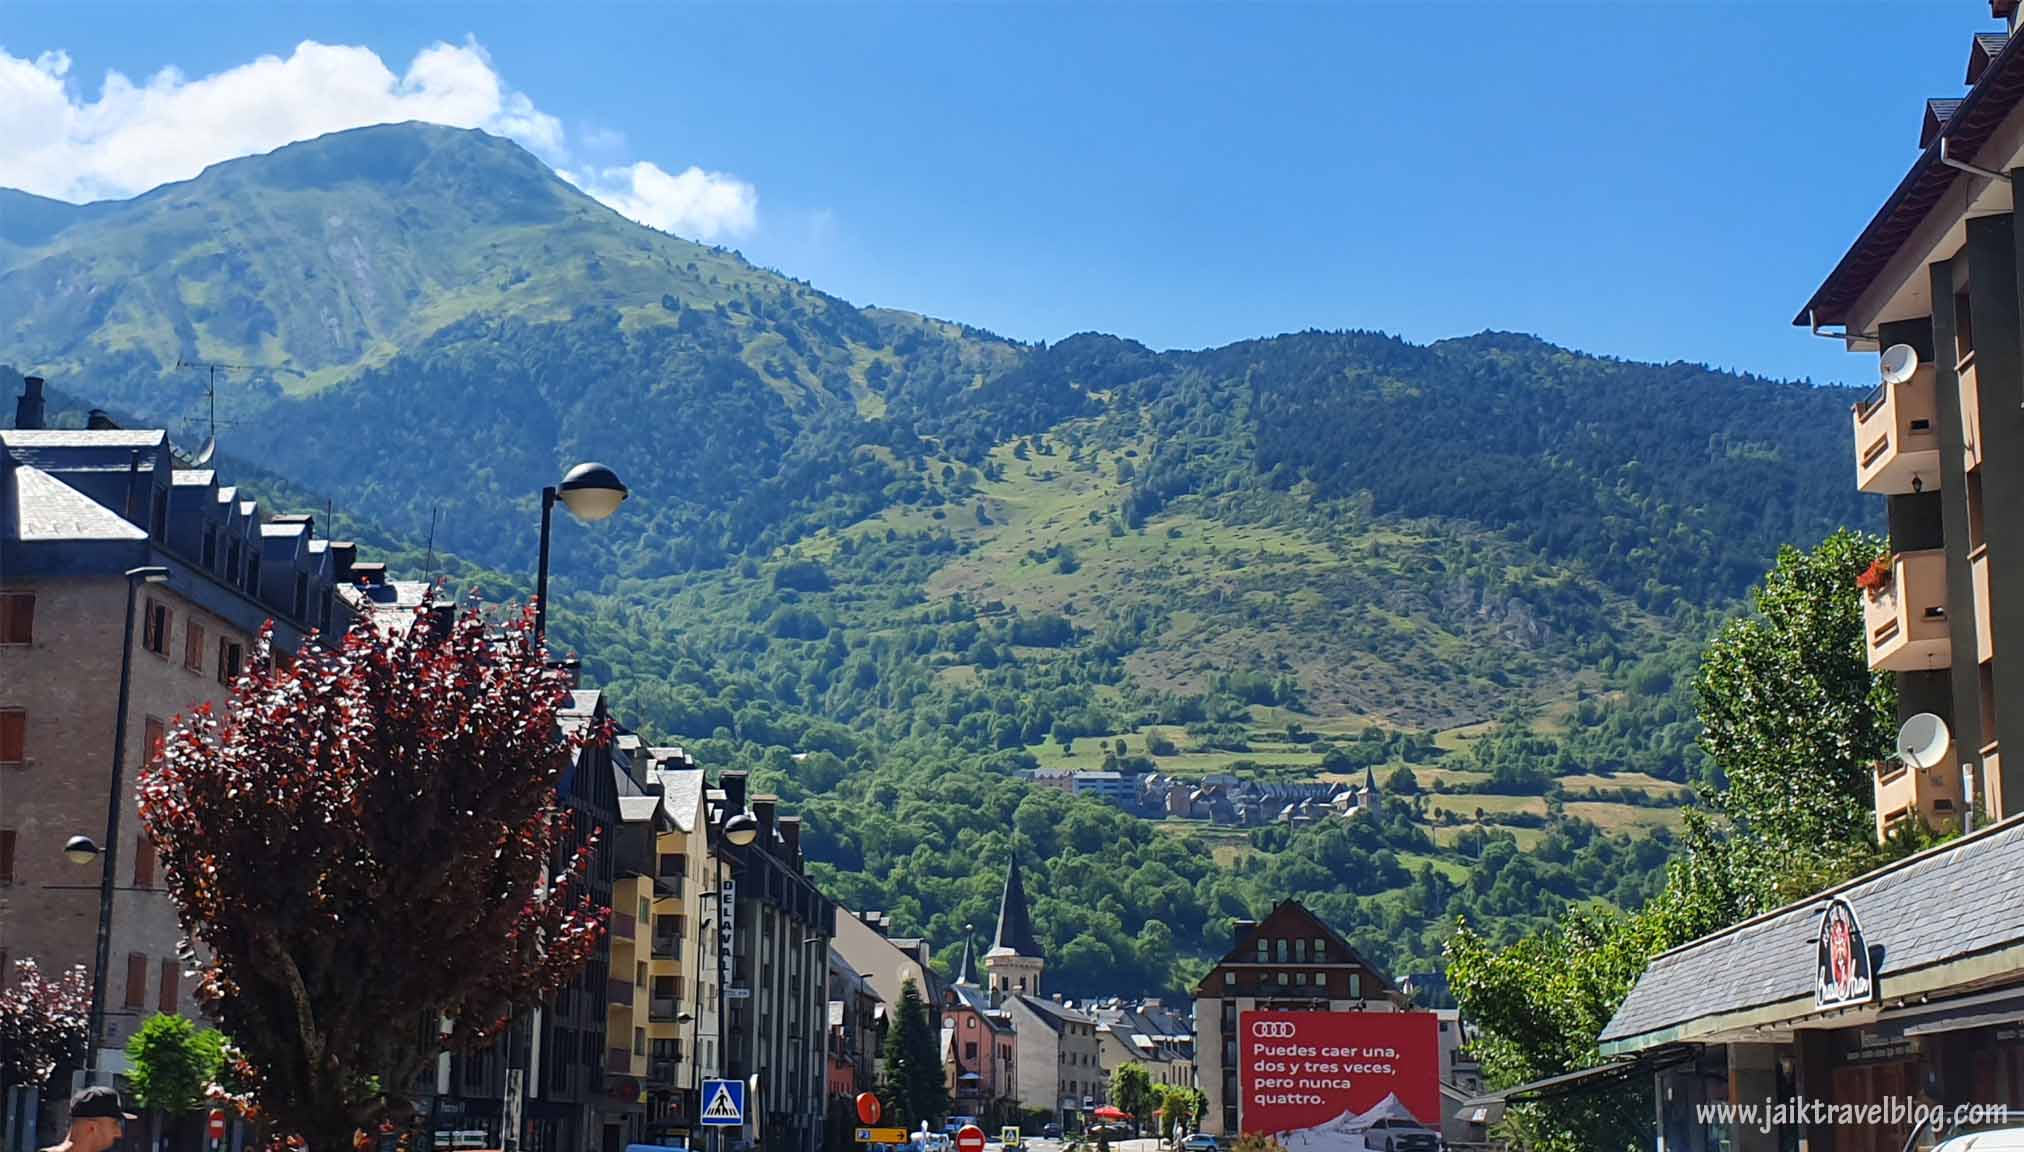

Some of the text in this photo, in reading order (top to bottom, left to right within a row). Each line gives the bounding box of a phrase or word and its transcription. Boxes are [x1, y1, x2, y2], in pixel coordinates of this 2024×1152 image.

[1253, 1043, 1401, 1060] Puedes caer una,
[1253, 1059, 1397, 1076] dos y tres veces,
[1254, 1077, 1352, 1090] pero nunca
[1254, 1093, 1326, 1107] quattro.
